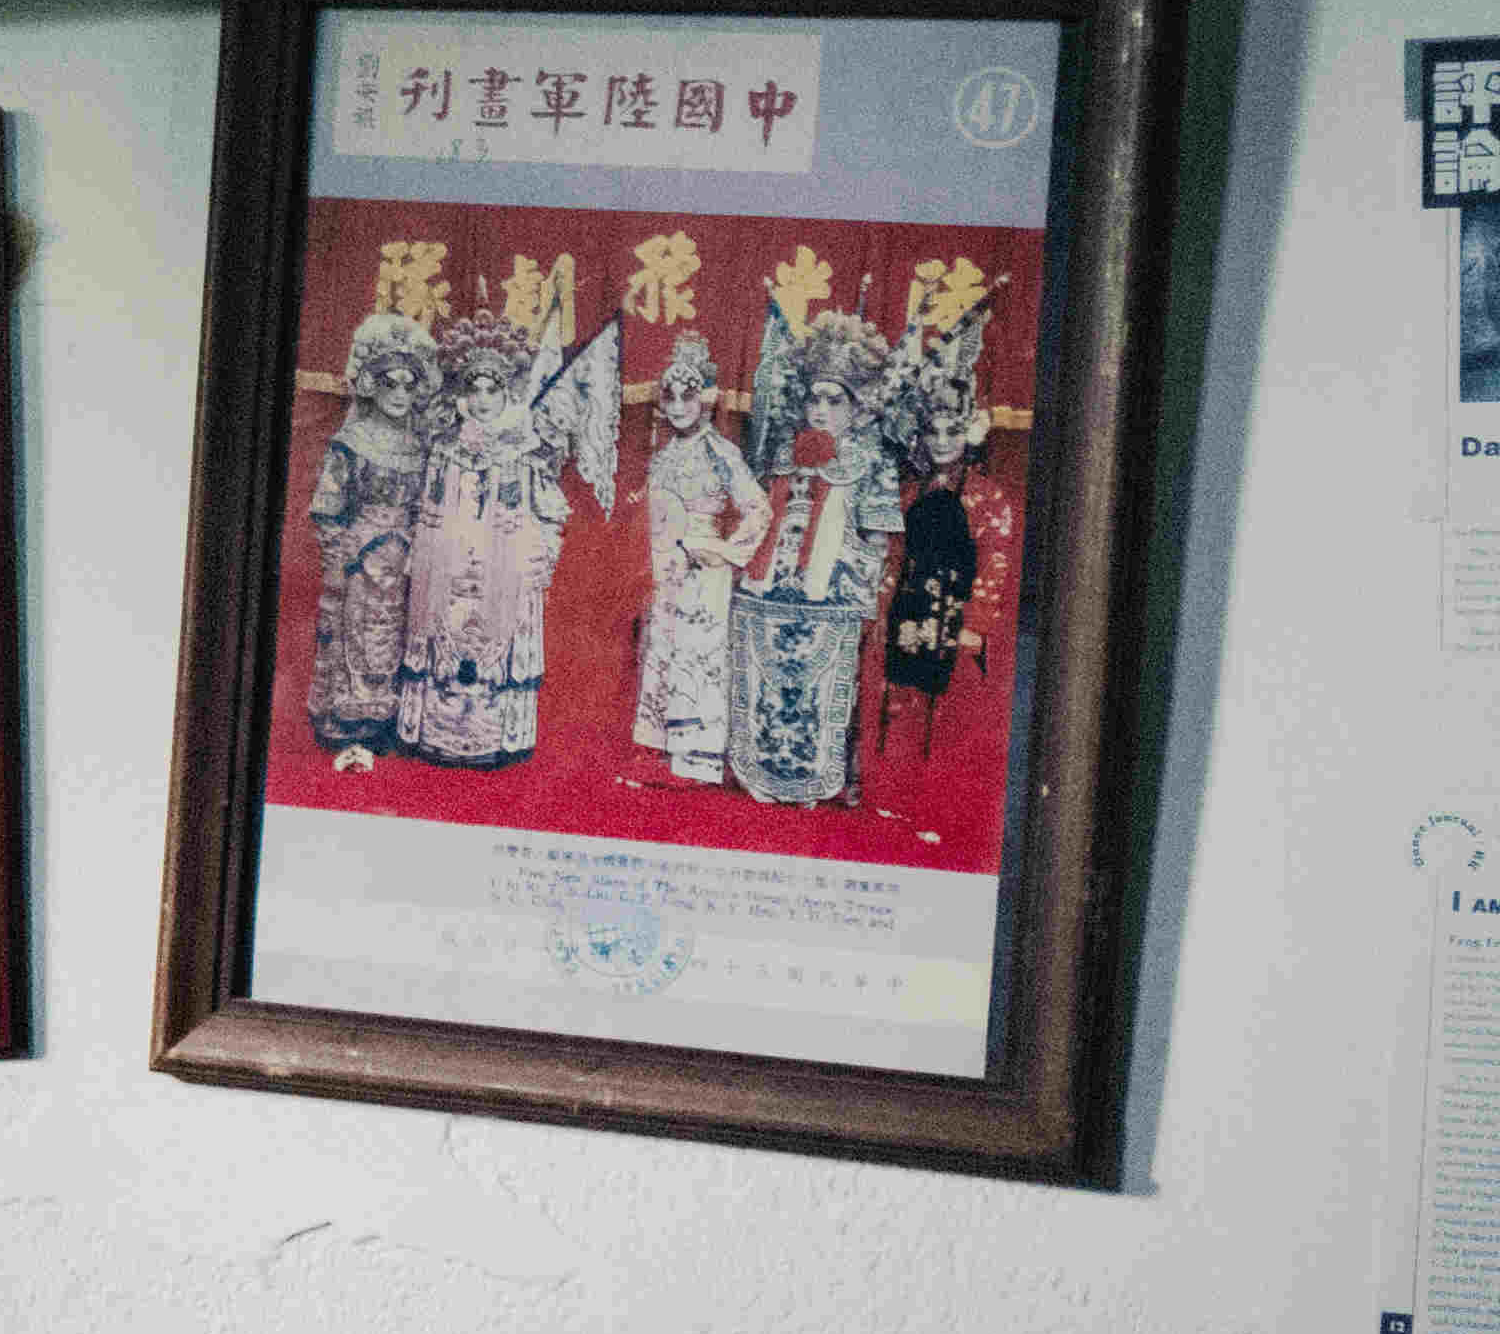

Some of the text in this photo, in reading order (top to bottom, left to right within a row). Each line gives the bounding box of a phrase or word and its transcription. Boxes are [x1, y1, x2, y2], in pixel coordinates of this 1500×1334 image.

[399, 66, 799, 148] 中國陸軍畫刊
